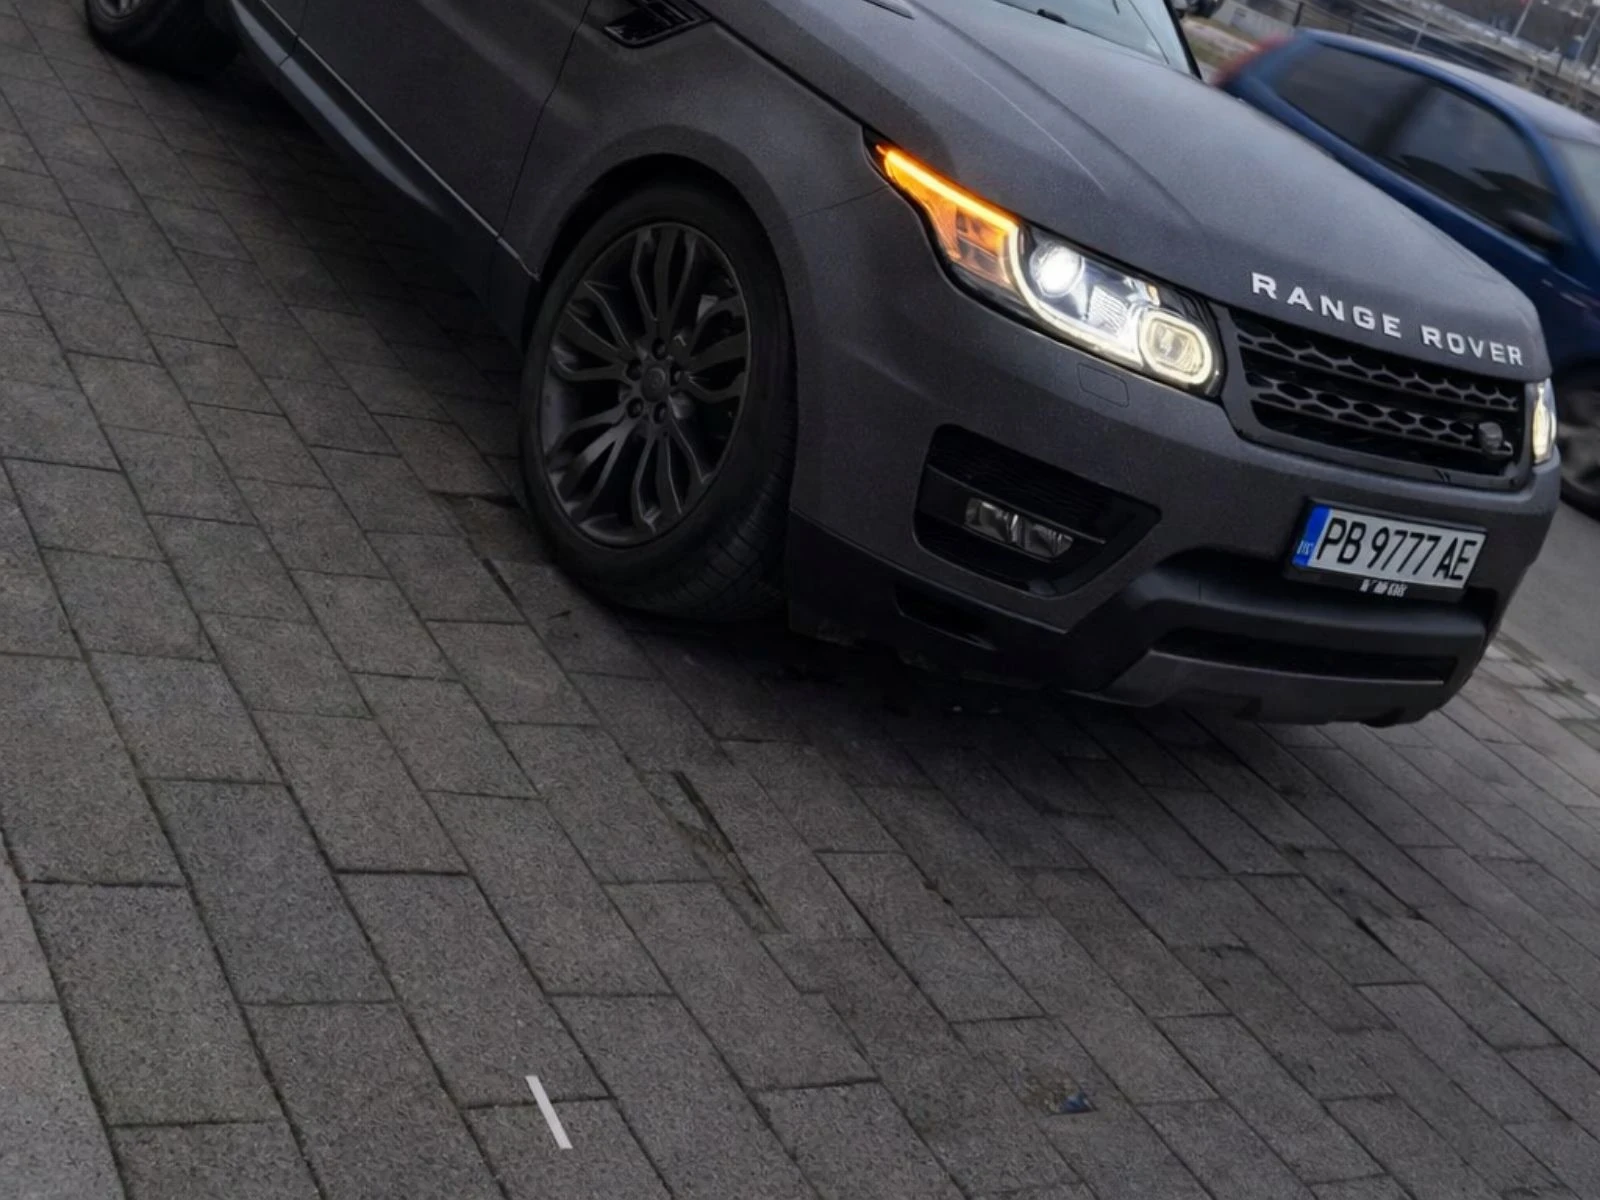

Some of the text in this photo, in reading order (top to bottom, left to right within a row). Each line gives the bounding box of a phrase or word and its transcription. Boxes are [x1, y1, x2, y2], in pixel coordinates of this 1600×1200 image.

[1252, 272, 1523, 365] RANGE ROVER
[1316, 517, 1477, 581] PB 9777 AE
